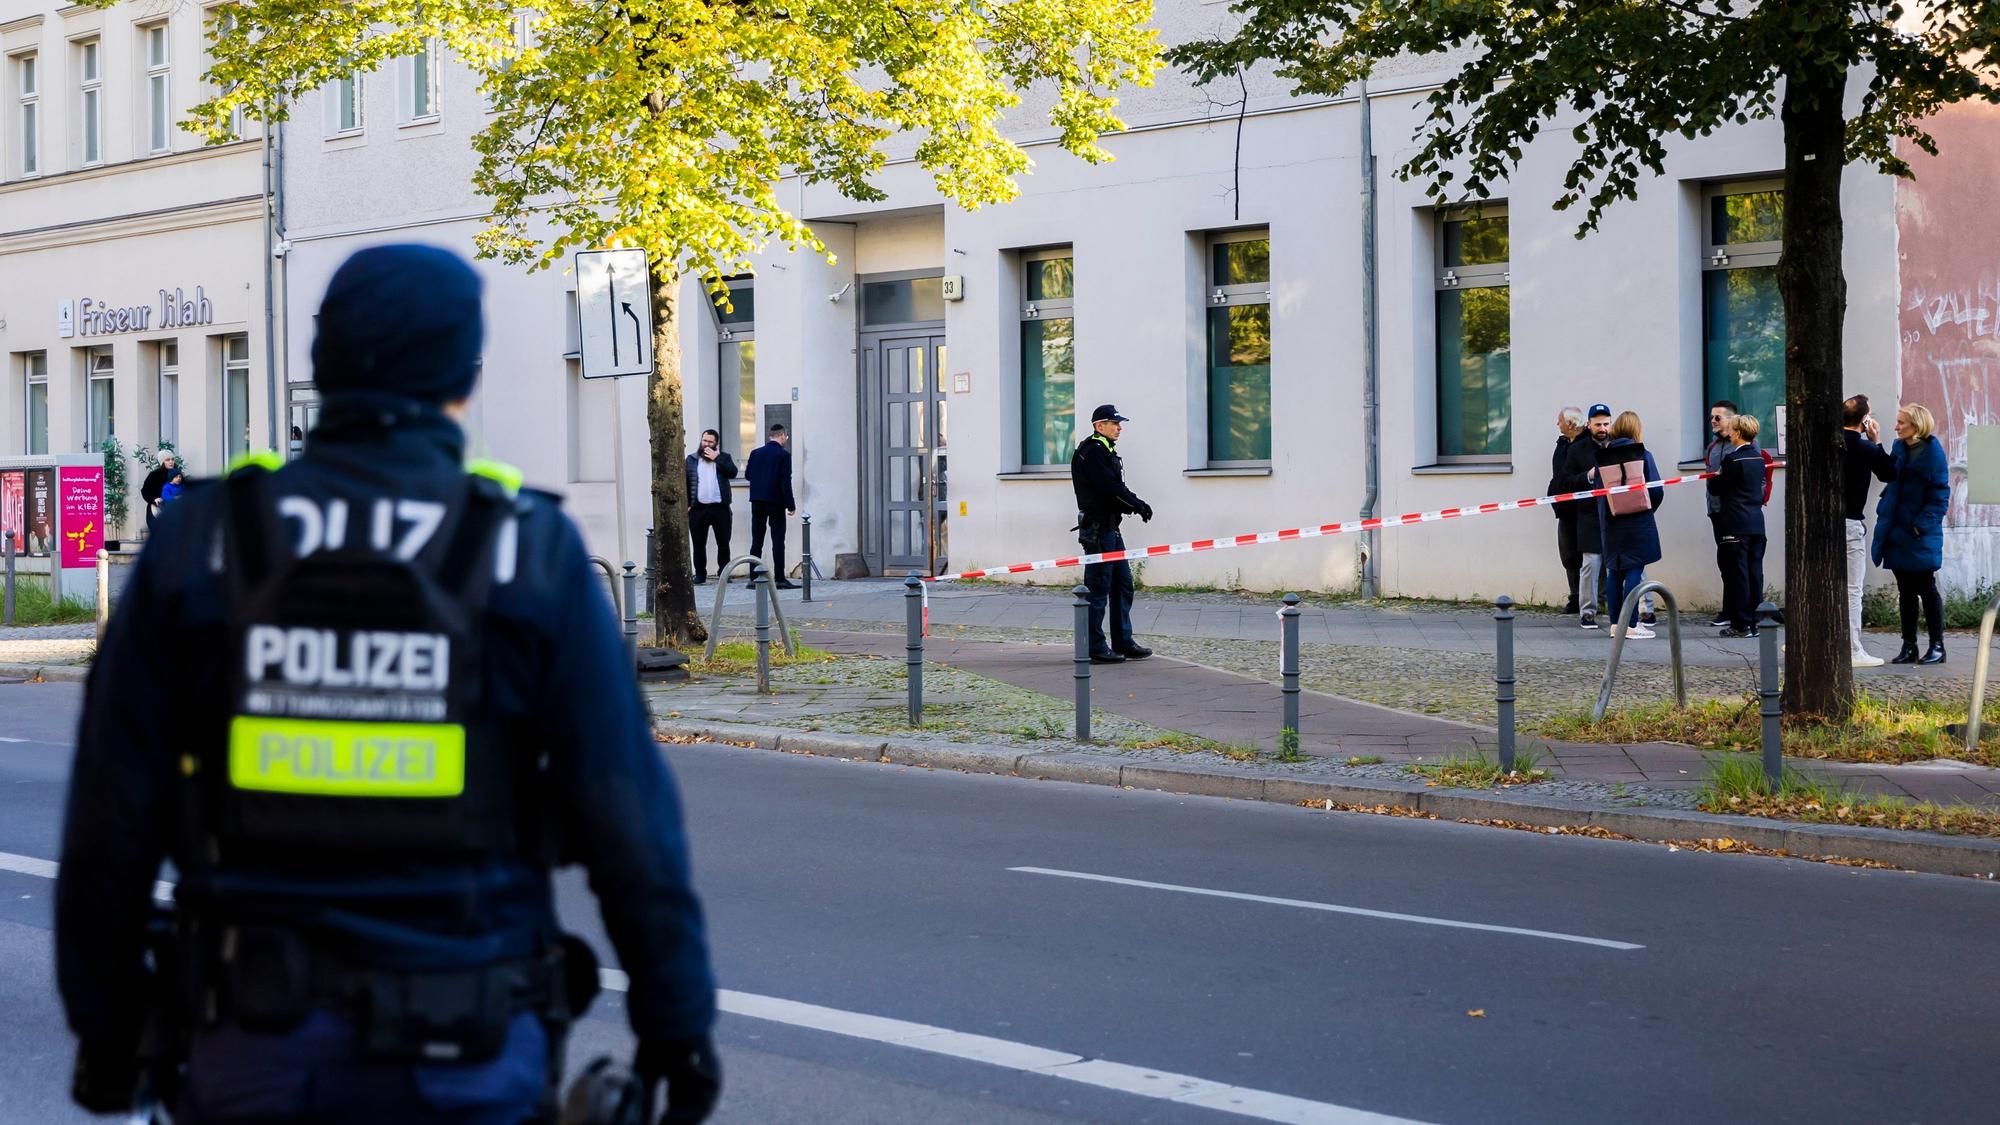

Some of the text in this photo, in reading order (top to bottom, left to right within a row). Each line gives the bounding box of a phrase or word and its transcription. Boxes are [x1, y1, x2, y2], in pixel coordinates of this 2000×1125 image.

[944, 281, 954, 294] 33
[80, 297, 151, 336] Friseur
[66, 495, 98, 503] Werbung
[247, 625, 449, 690] POLIZEI
[257, 731, 438, 784] POLIZEI
